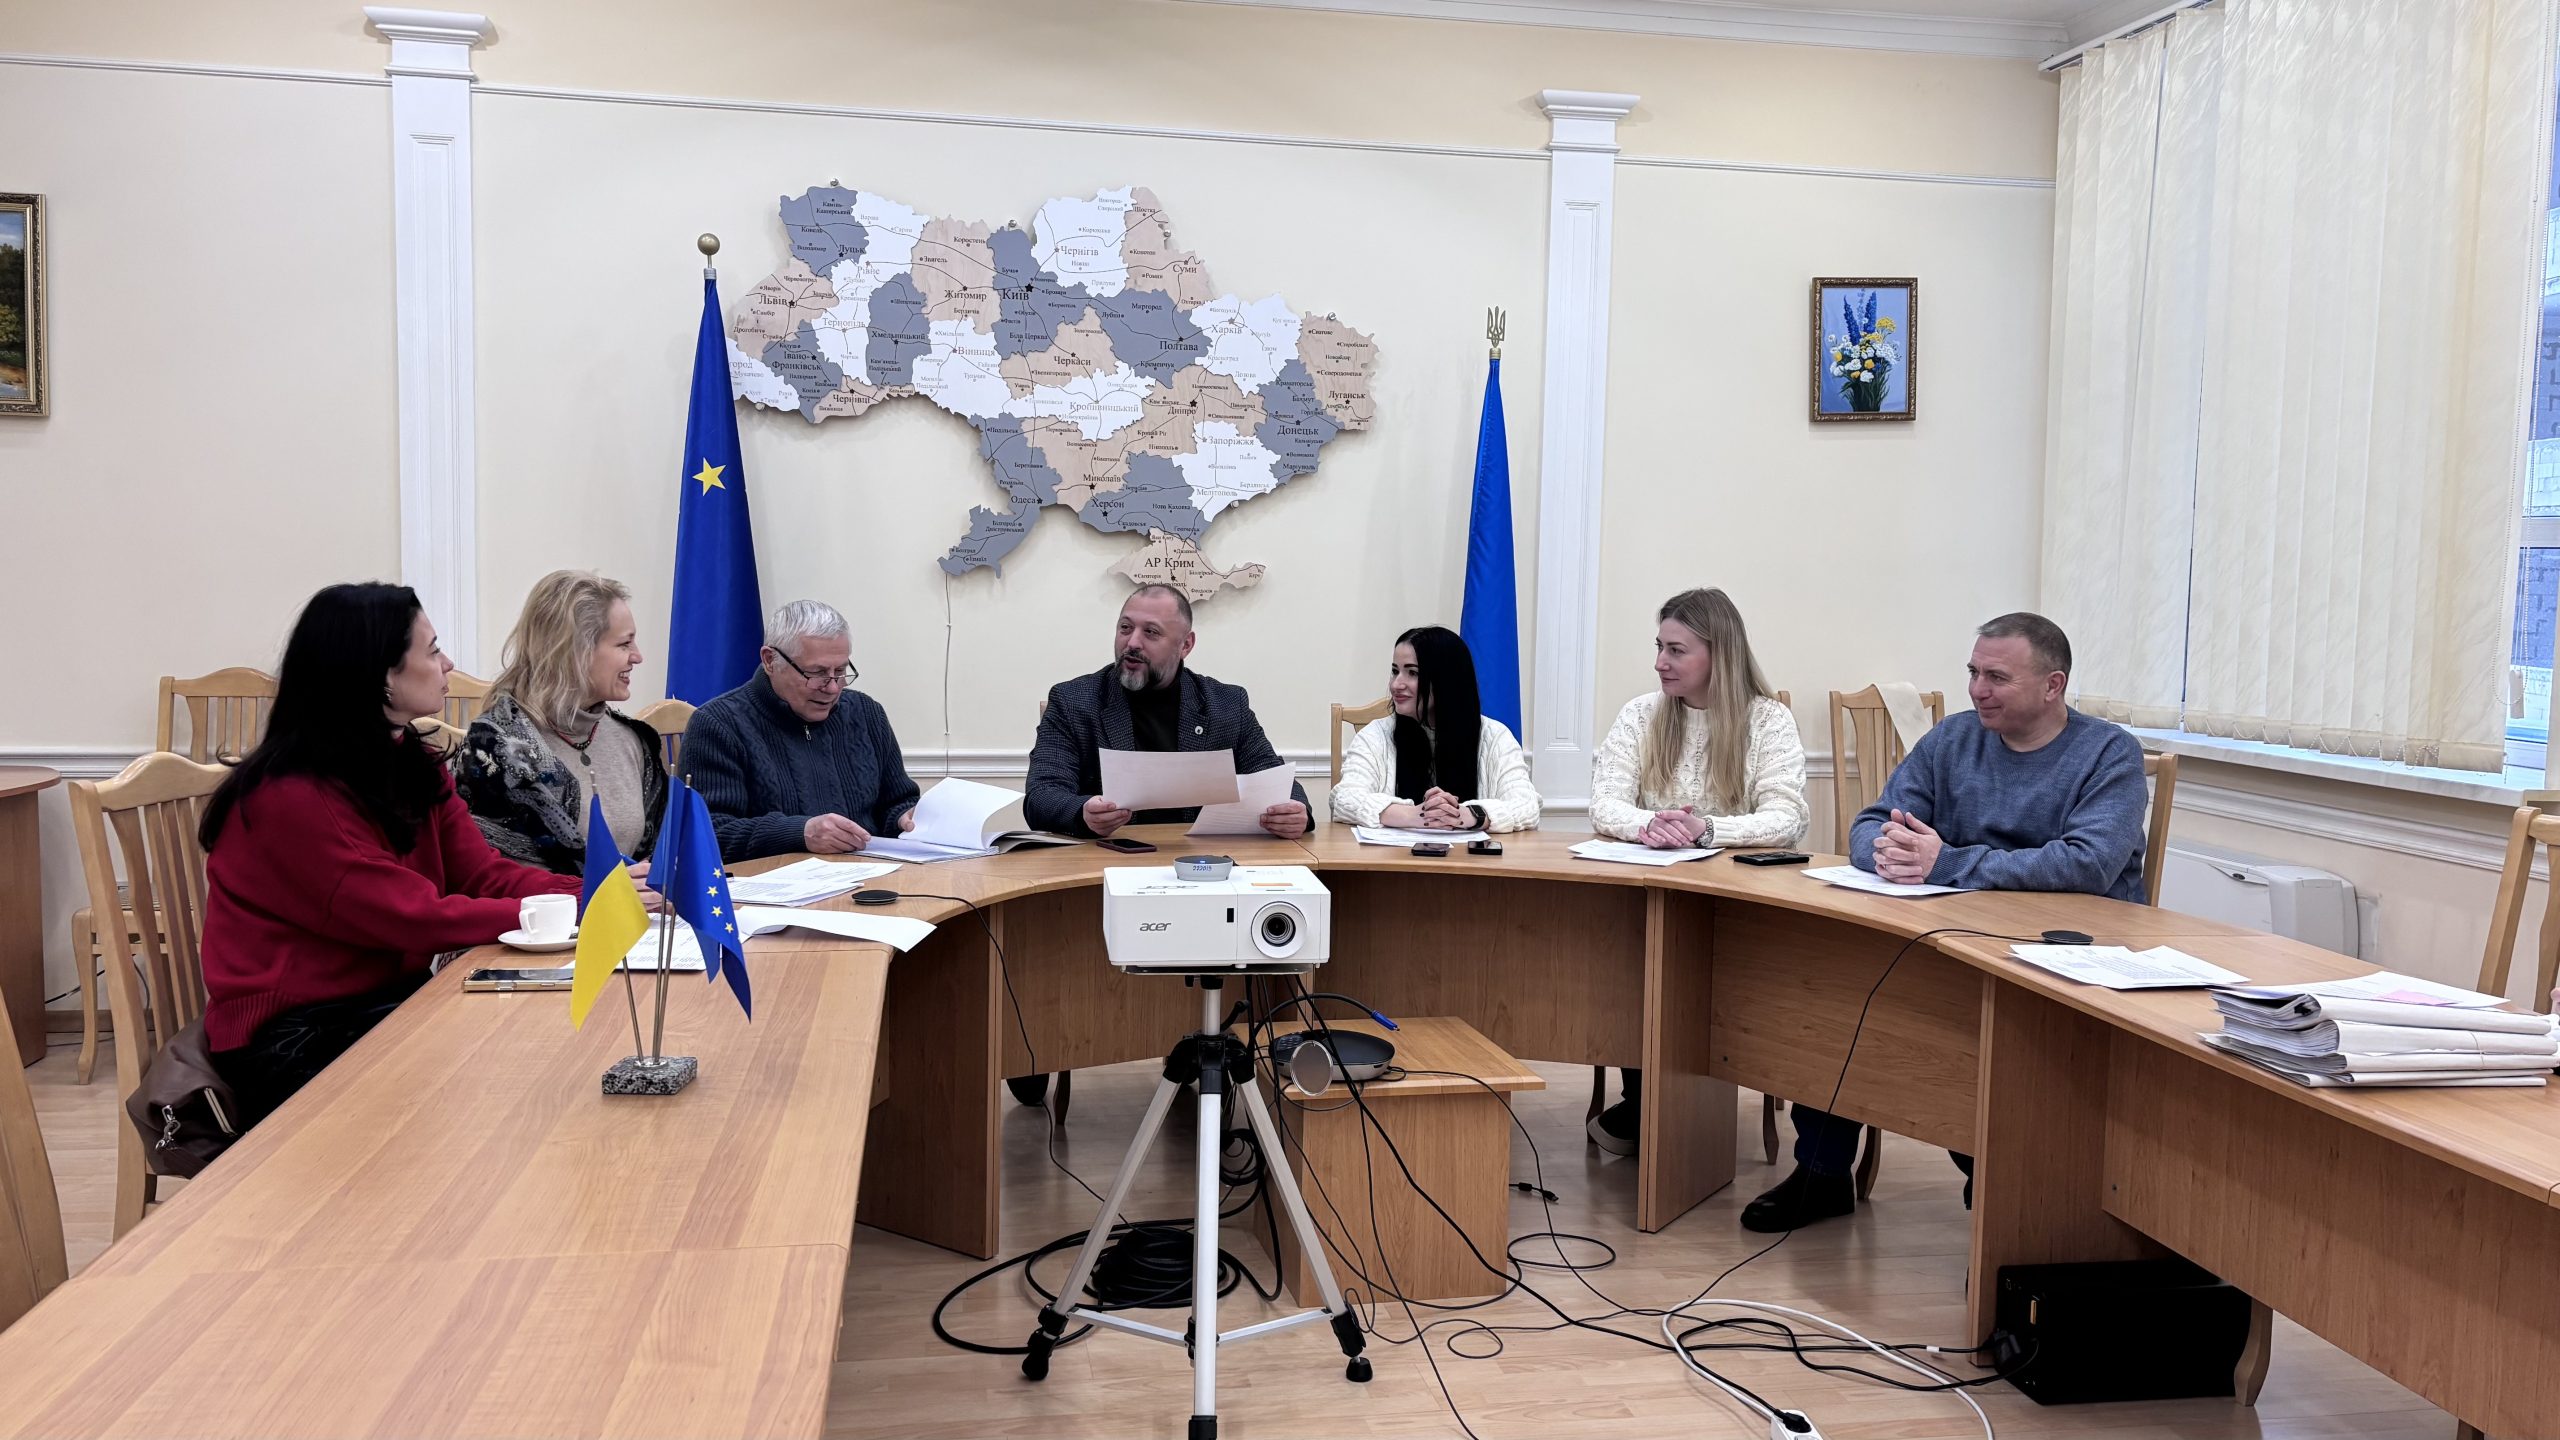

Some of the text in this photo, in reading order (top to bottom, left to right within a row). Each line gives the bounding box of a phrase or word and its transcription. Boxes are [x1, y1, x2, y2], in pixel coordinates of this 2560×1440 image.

[953, 236, 986, 244] Коростень
[838, 245, 865, 254] Луцьк
[1061, 246, 1099, 257] Чернігів
[857, 266, 880, 275] Рівне
[1172, 264, 1197, 274] Суми
[944, 290, 987, 301] Житомир
[1002, 289, 1029, 300] Київ
[759, 295, 787, 305] Львів
[1102, 311, 1120, 319] Лубни
[822, 318, 865, 327] Тернопіль
[872, 331, 925, 340] Хмельницький
[1211, 325, 1242, 336] Харків
[1159, 341, 1199, 351] Полтава
[784, 351, 810, 359] Івано-
[958, 347, 995, 356] Вінниця
[729, 361, 753, 369] город
[772, 361, 821, 371] Франківськ
[1054, 356, 1091, 367] Черкаси
[833, 395, 870, 404] Чернівці
[1328, 391, 1366, 401] Луганськ
[1070, 402, 1139, 412] Кропивницький
[1168, 406, 1196, 417] Дніпро
[1277, 426, 1319, 436] Донецьк
[1209, 436, 1255, 446] Запоріжжя
[1083, 474, 1121, 482] Миколаїв
[1197, 489, 1238, 497] Мелітополь
[1010, 495, 1036, 504] Одеса
[1091, 499, 1125, 509] Херсон
[1144, 558, 1194, 570] АР Крим
[1139, 922, 1171, 932] acer
